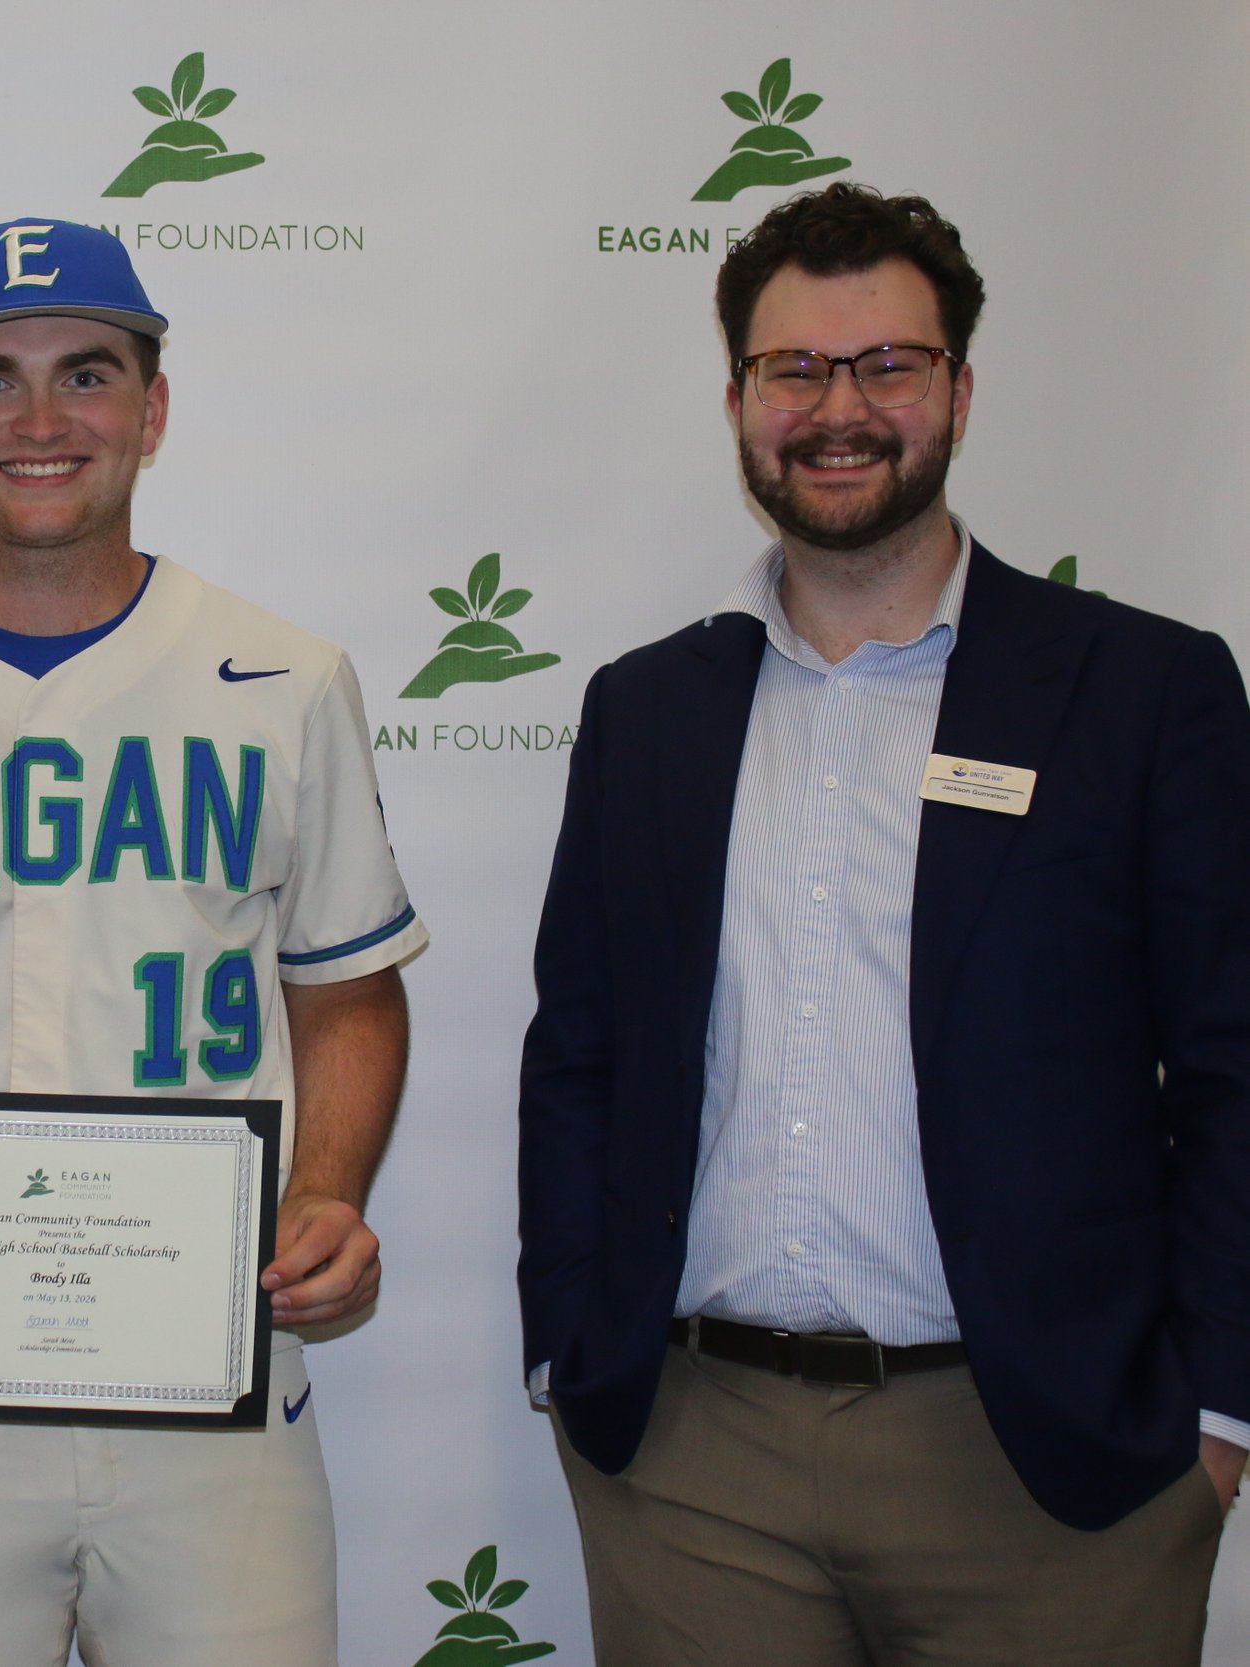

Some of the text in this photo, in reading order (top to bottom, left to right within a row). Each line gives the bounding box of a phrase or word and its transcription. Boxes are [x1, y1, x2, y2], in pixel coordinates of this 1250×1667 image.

[137, 223, 363, 250] FOUNDATION
[598, 226, 710, 253] EAGAN
[433, 724, 580, 751] FOUNDA
[969, 771, 1005, 782] UNITED WAY
[941, 784, 1010, 800] Jackson Gunvalson
[134, 949, 261, 1086] 19
[61, 1171, 111, 1182] EAGAN
[60, 1183, 111, 1191] COMMUNITY
[59, 1192, 112, 1200] FOUNDATION
[15, 1212, 81, 1229] Community
[84, 1214, 151, 1228] Foundation
[38, 1229, 86, 1239] Presents the
[17, 1241, 59, 1255] School
[59, 1242, 112, 1257] Baseball
[112, 1244, 180, 1262] Scholarship
[30, 1272, 91, 1288] Brody Illa
[23, 1294, 34, 1302] on
[36, 1293, 57, 1305] May
[75, 1295, 97, 1304] 2026
